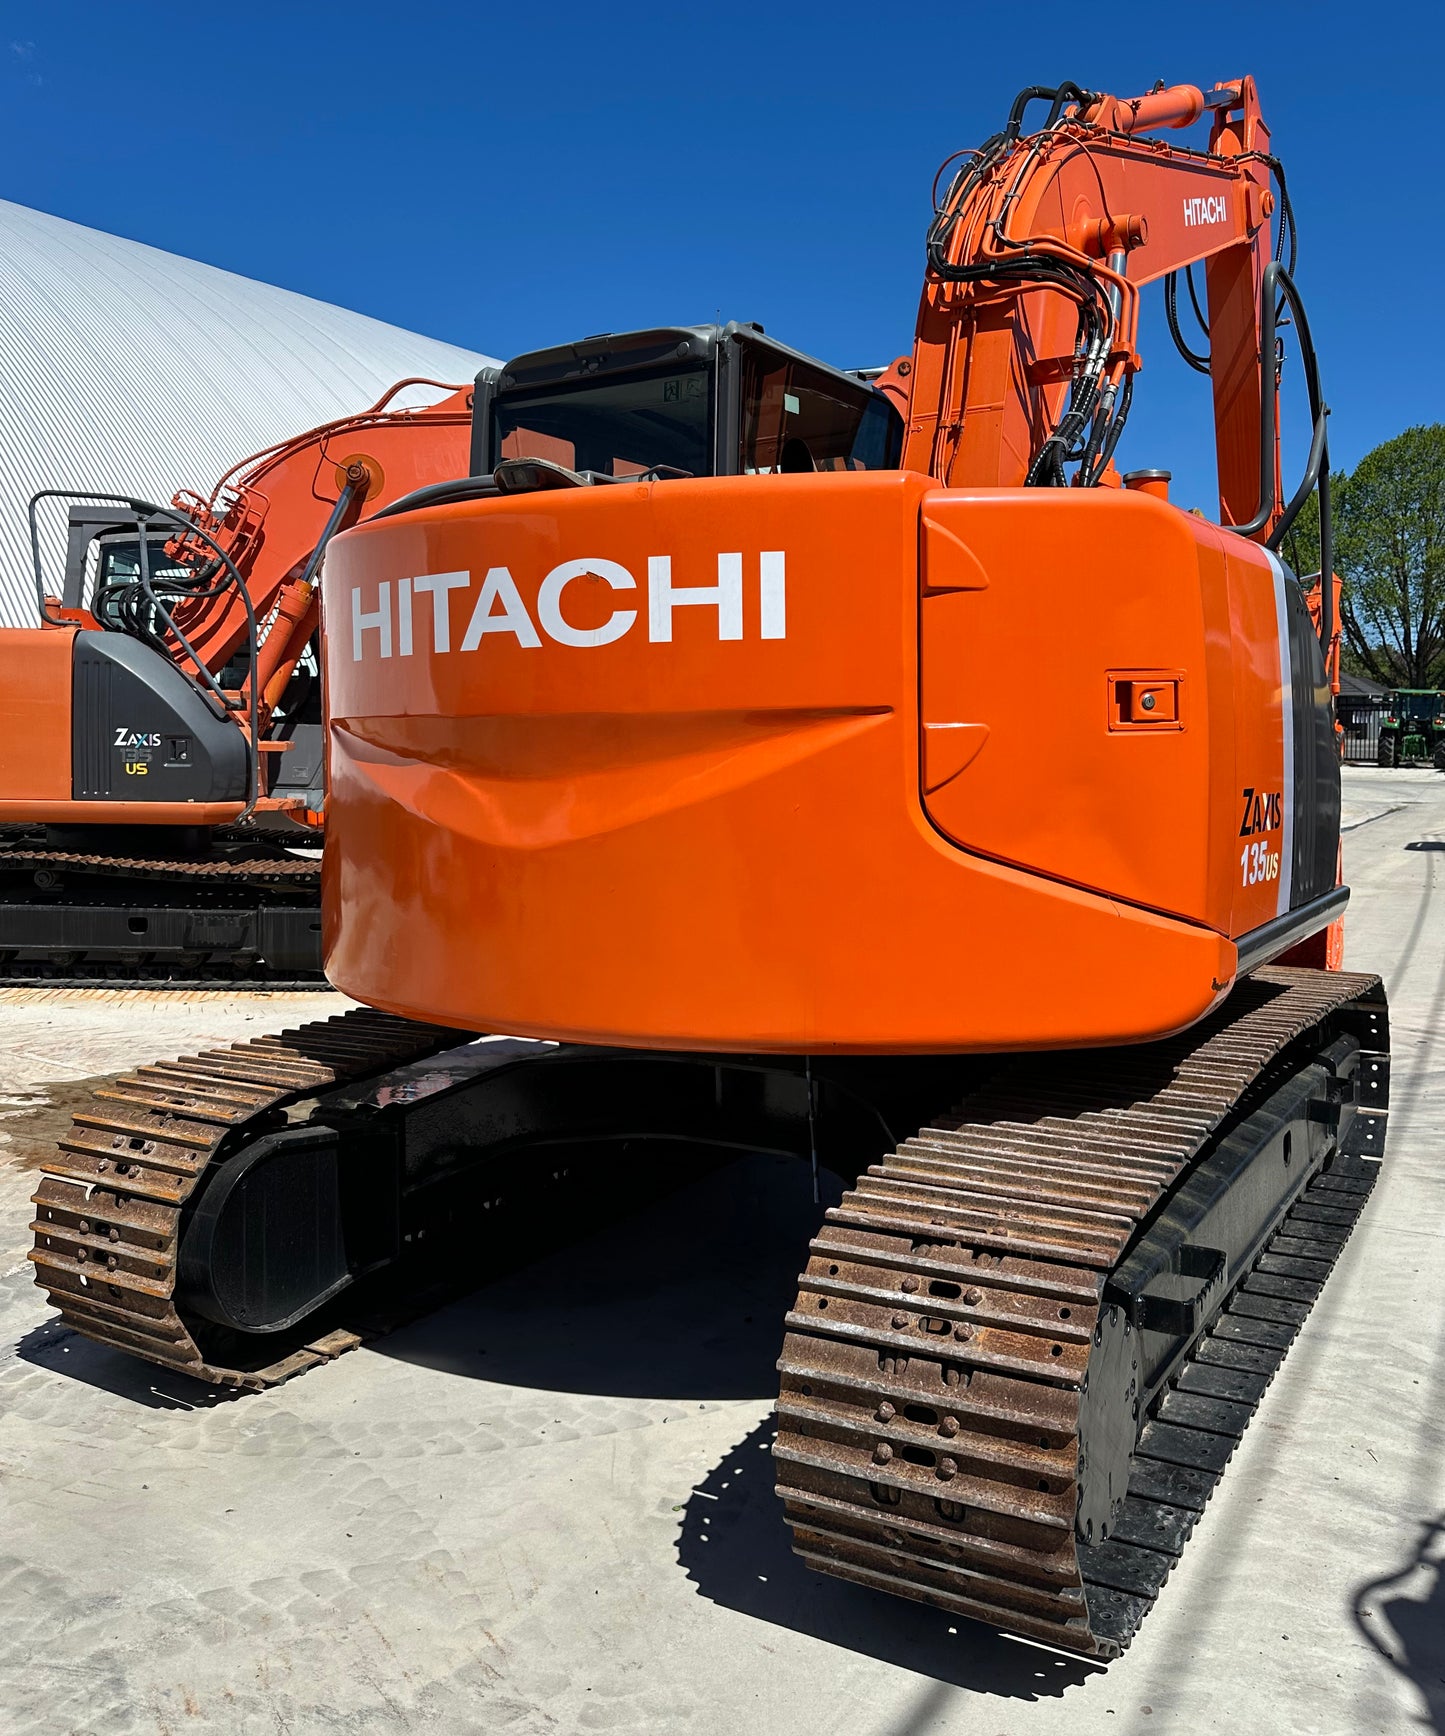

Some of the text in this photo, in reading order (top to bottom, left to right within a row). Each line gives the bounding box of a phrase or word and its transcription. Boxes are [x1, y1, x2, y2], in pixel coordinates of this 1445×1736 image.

[1183, 196, 1227, 227] HITACHI
[351, 550, 786, 661] HITACHI
[113, 727, 162, 749] ZAXIS
[125, 762, 149, 775] US
[1239, 787, 1281, 837] ZAXIS
